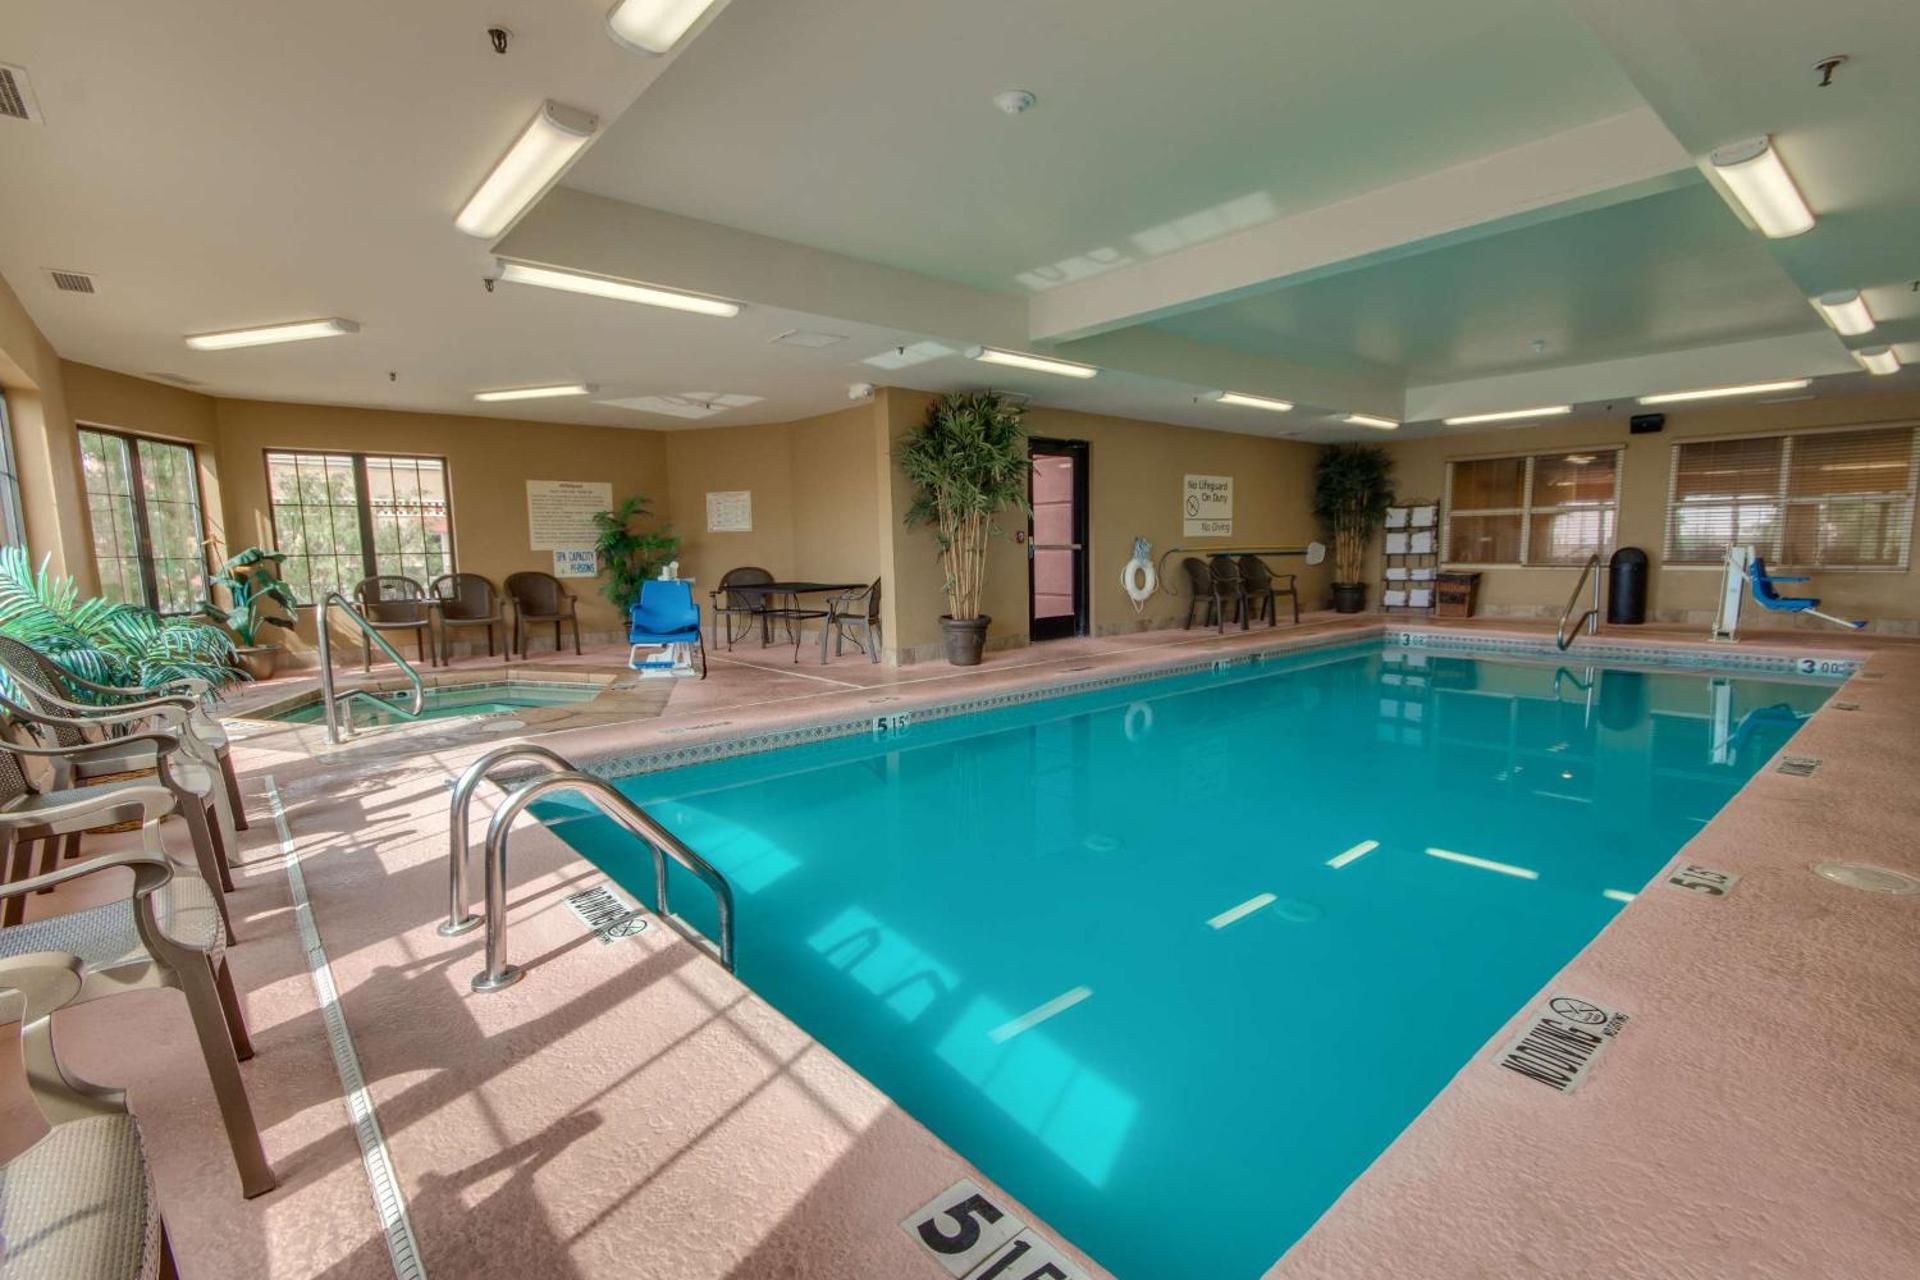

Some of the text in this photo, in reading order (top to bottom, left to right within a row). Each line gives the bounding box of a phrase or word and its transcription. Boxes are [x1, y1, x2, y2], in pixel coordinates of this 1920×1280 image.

[1187, 480, 1228, 492] No Lifeguard
[1201, 492, 1228, 504] On Duty
[1801, 659, 1816, 674] 3
[1501, 1017, 1603, 1092] NO DIVING
[916, 1192, 1005, 1256] 5
